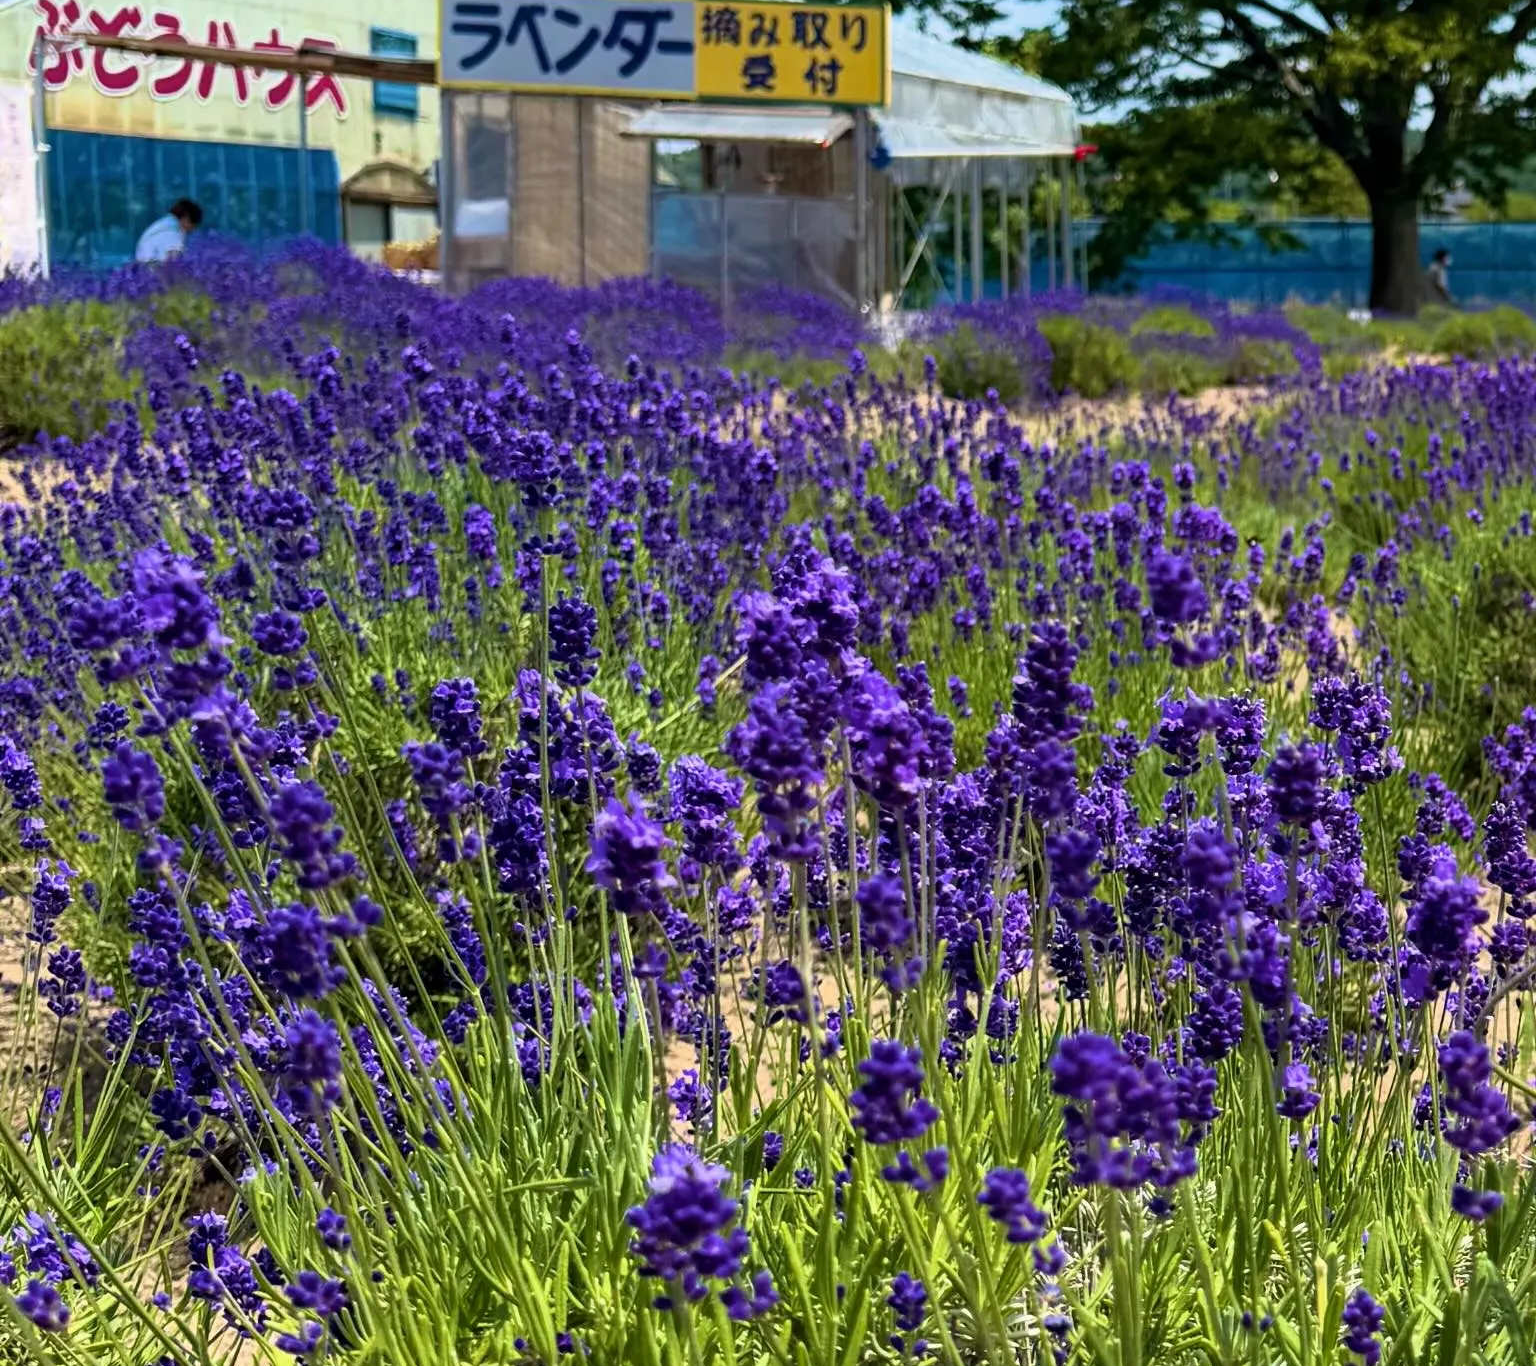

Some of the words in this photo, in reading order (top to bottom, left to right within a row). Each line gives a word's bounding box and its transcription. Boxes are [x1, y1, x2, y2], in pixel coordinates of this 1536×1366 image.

[452, 2, 693, 77] ラベンダー
[702, 6, 867, 52] 摘み取り
[741, 53, 844, 96] 受付
